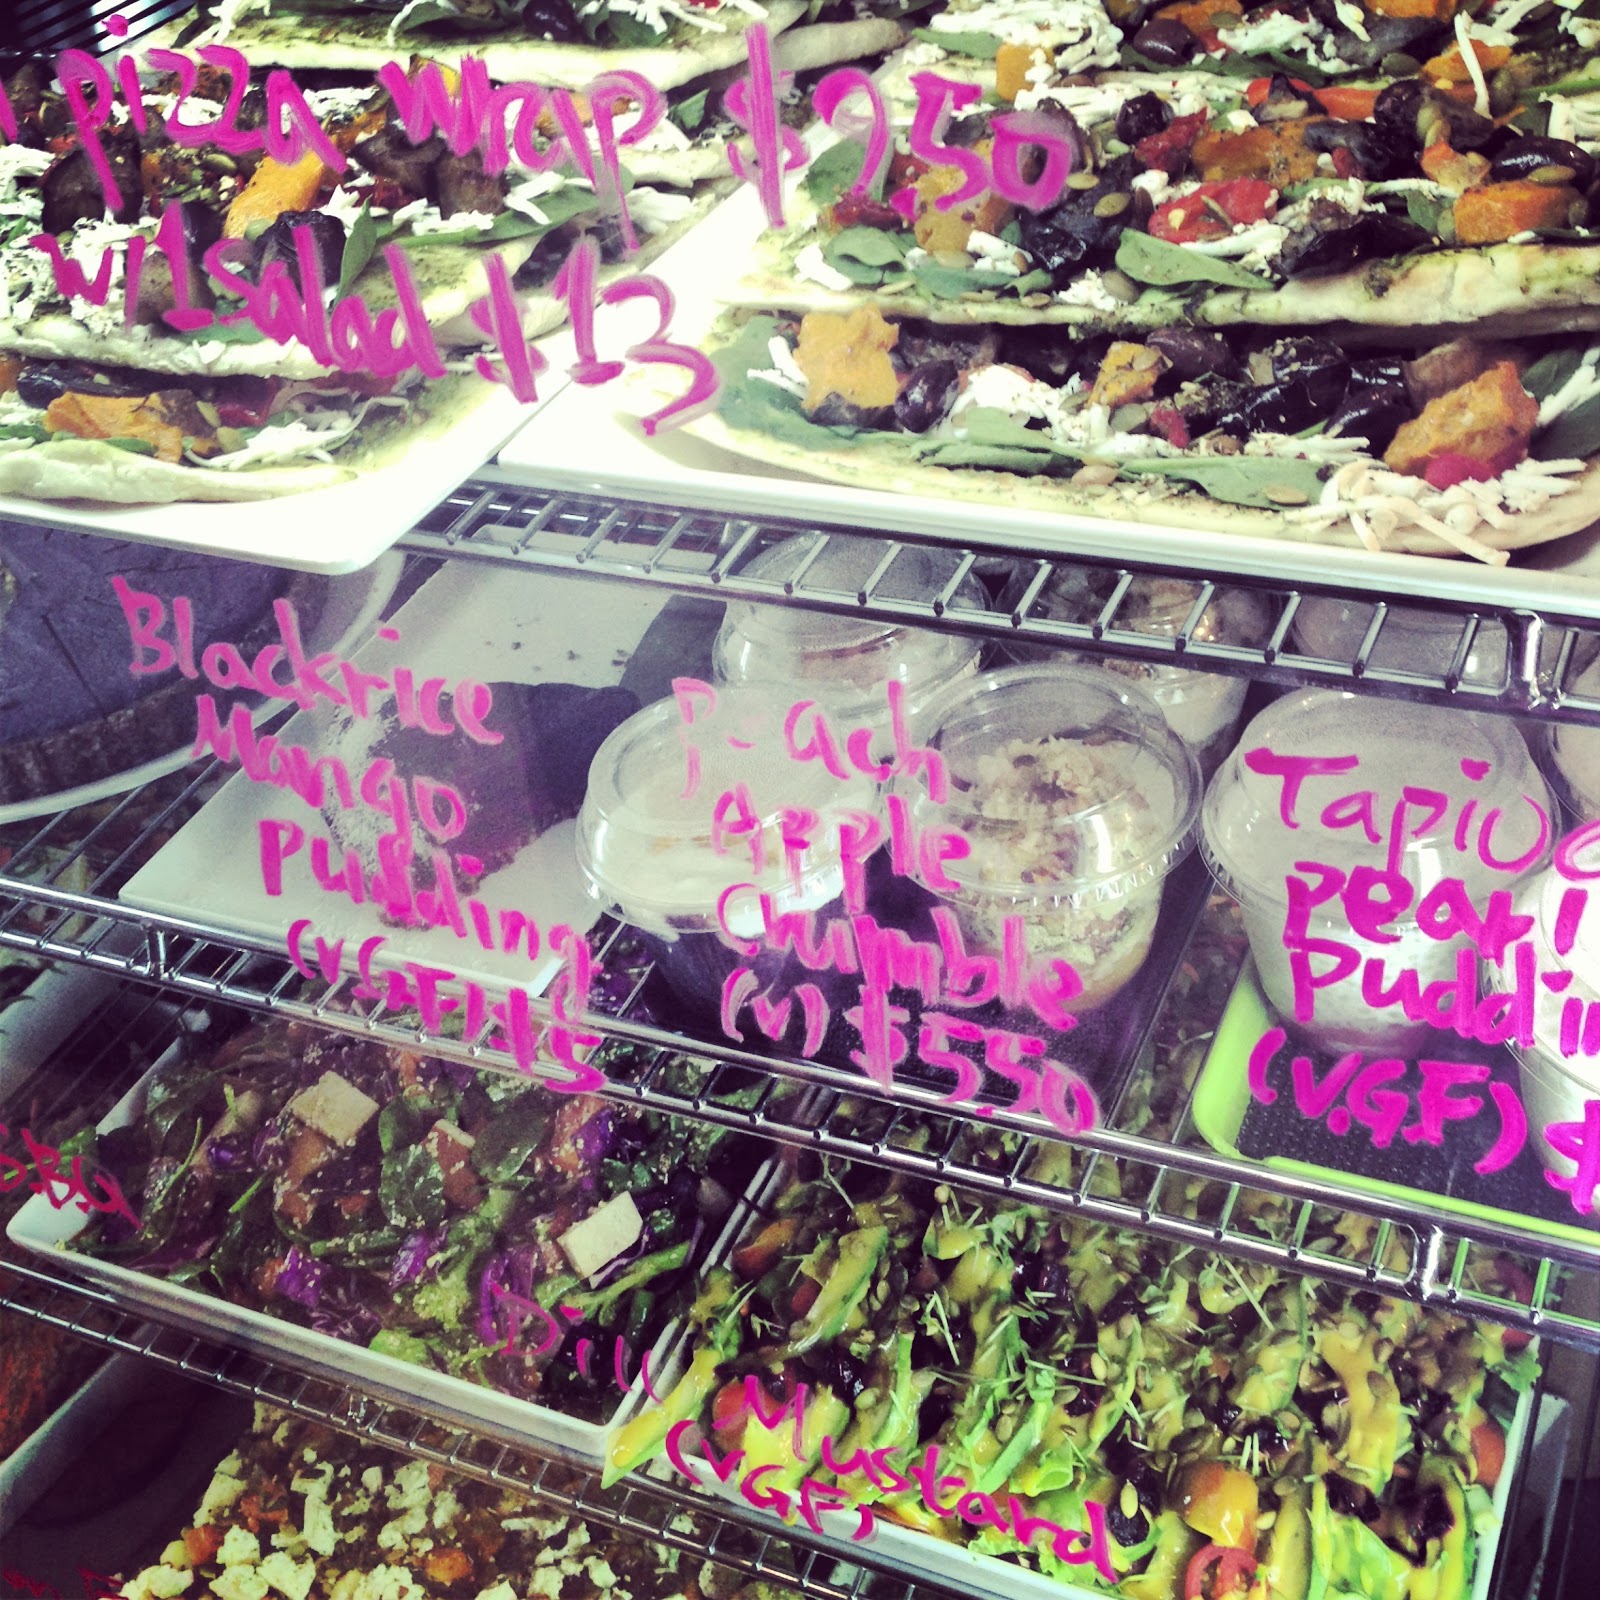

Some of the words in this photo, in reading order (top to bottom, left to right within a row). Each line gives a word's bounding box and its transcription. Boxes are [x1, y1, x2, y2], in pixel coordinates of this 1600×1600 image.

[192, 694, 468, 845] Mango
[672, 676, 948, 804] Pach
[711, 782, 971, 914] Apple
[258, 818, 598, 1022] Pudding
